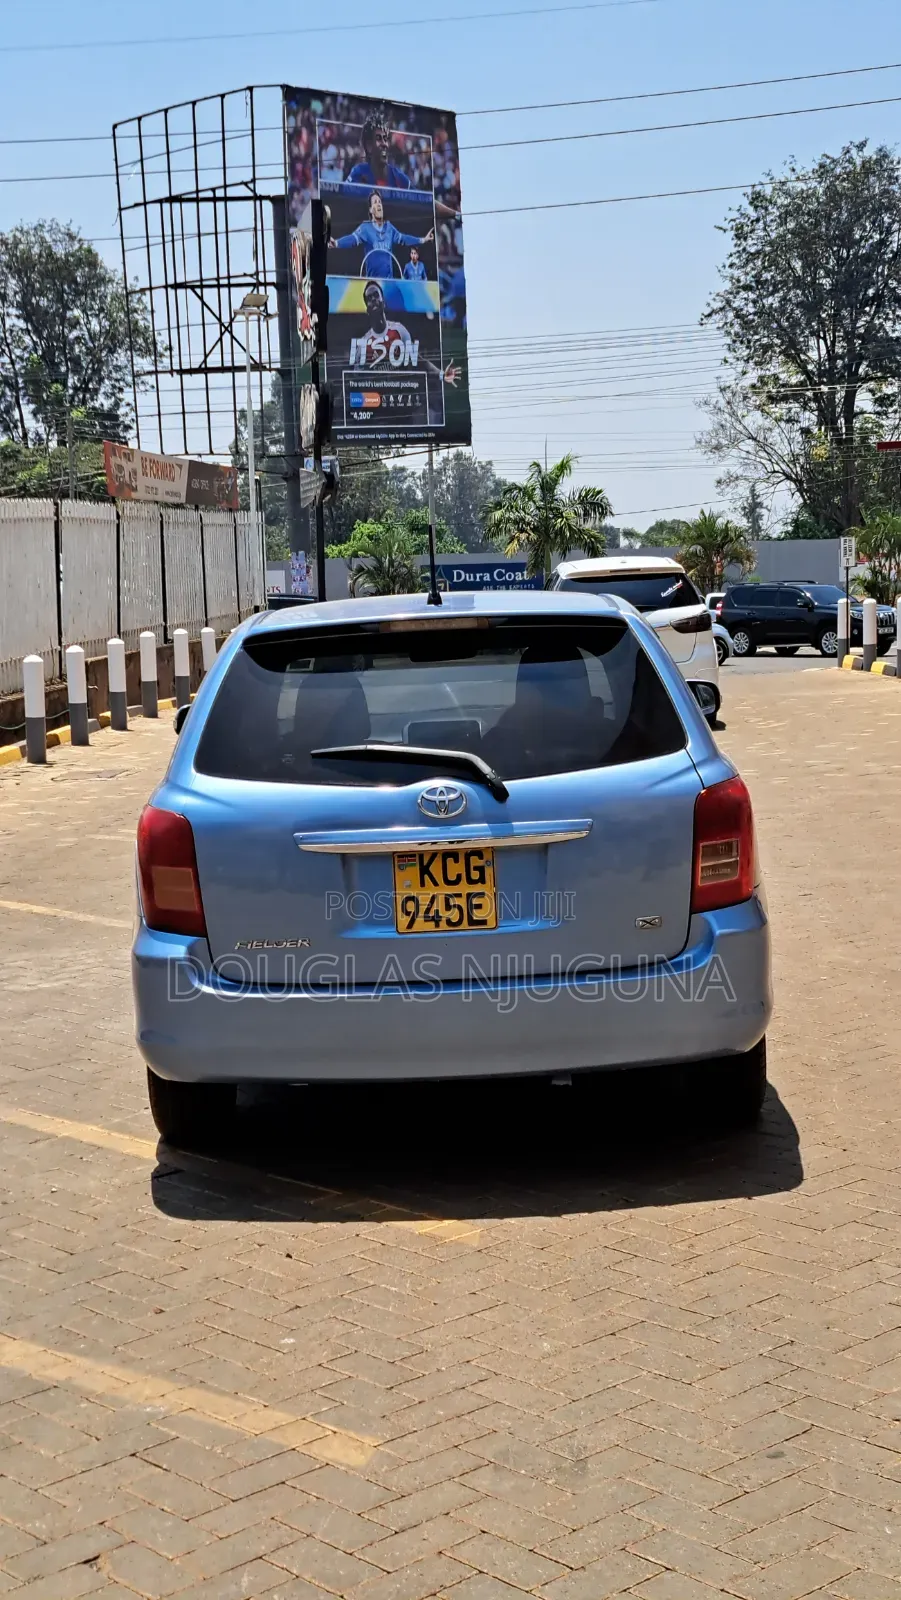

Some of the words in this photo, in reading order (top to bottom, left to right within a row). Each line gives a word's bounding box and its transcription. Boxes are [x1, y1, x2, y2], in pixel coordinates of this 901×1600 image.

[388, 339, 420, 367] ON
[400, 381, 419, 389] package
[140, 455, 149, 478] BE
[149, 457, 175, 482] FORWARD
[417, 850, 487, 888] KCG
[401, 891, 488, 930] 945E
[234, 937, 310, 950] FIELDER
